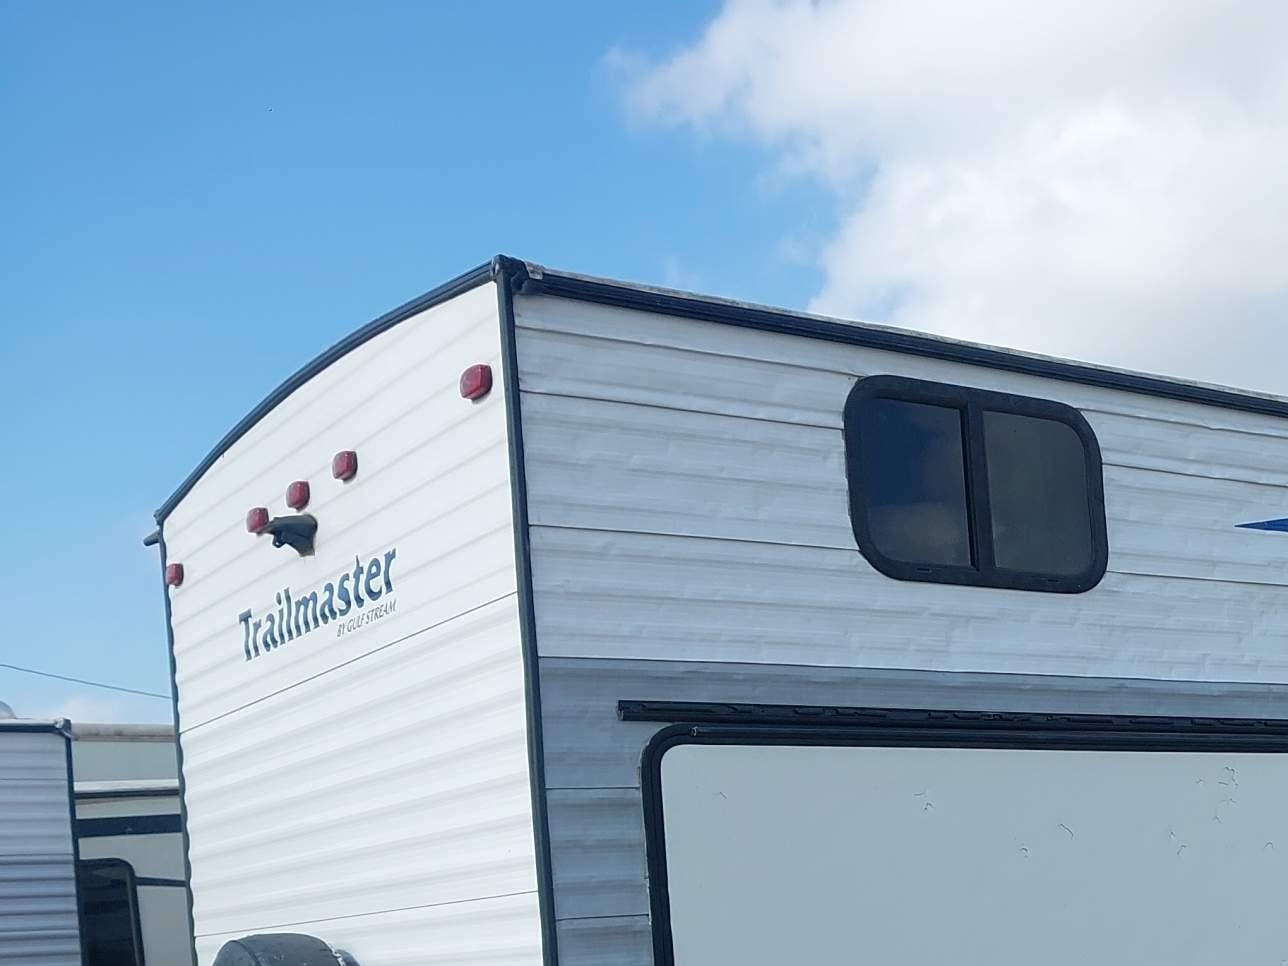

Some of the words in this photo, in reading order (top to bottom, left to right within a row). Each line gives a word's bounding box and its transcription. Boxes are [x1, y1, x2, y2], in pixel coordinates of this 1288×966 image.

[238, 548, 396, 662] Trailmaster
[336, 621, 347, 637] BY
[347, 613, 366, 633] GULF
[366, 599, 397, 625] STREAM
